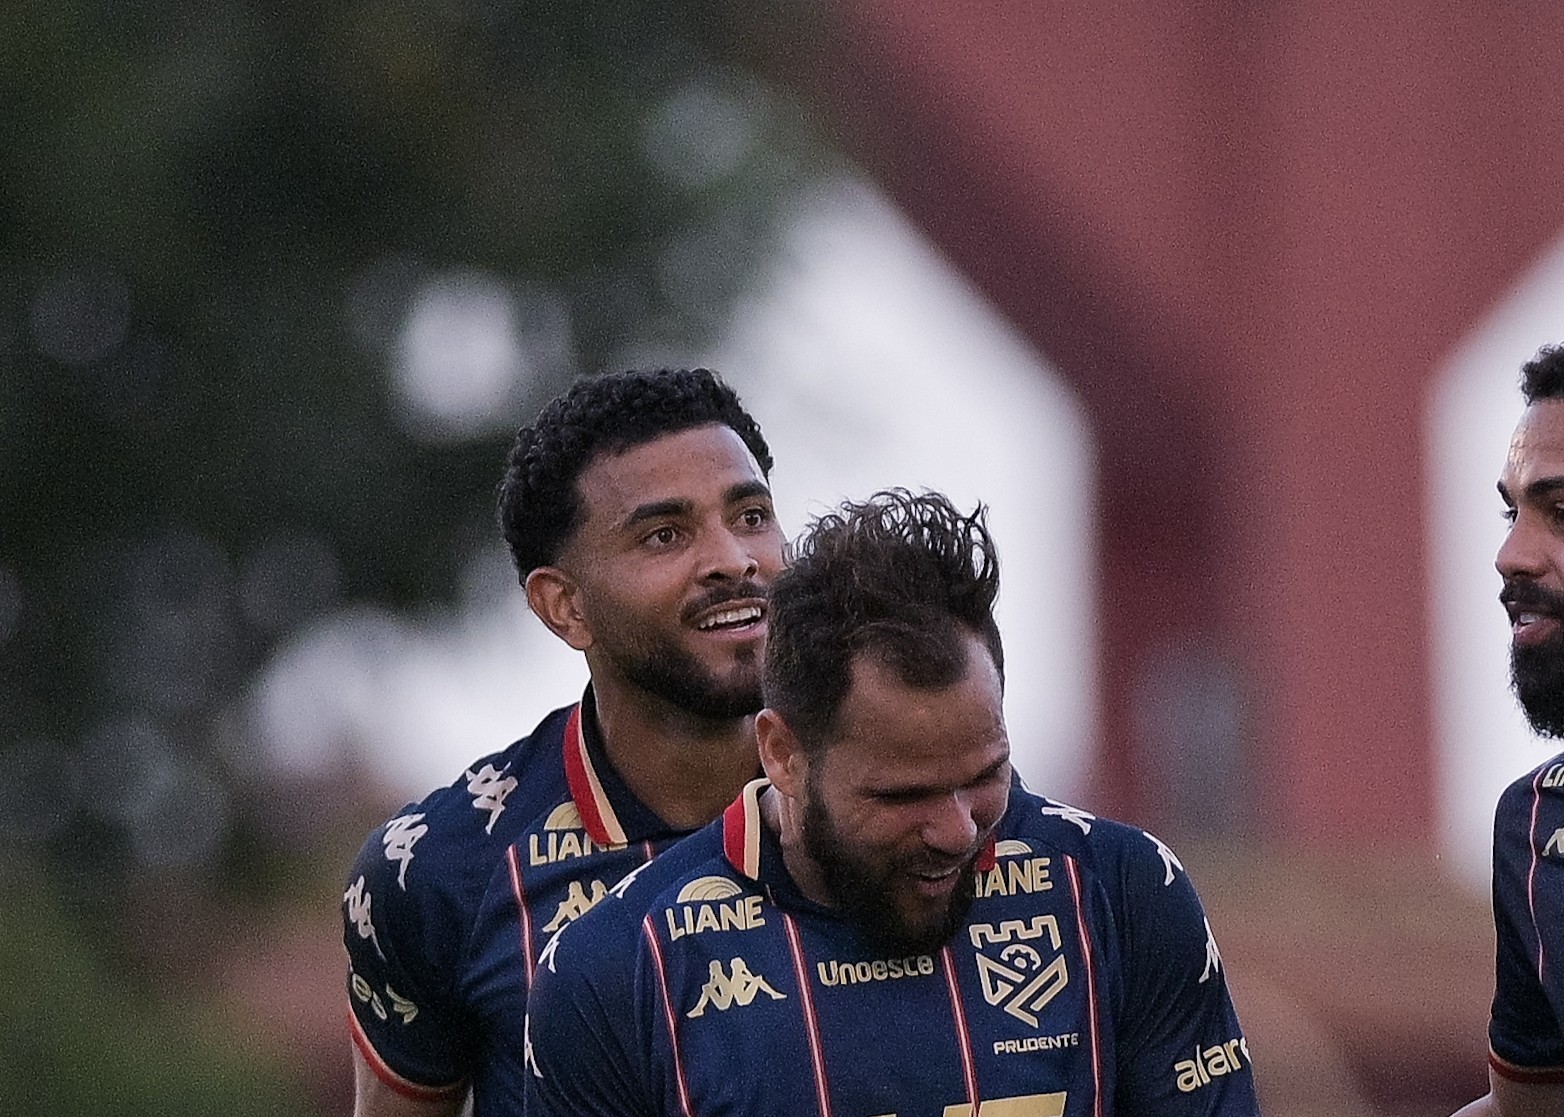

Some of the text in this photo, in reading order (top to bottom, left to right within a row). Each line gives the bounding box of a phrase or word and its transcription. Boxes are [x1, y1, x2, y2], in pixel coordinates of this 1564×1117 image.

[975, 857, 1054, 898] IANE
[665, 896, 766, 941] LIANE
[816, 954, 935, 987] Unoeste
[993, 1032, 1080, 1055] PRUDENTE
